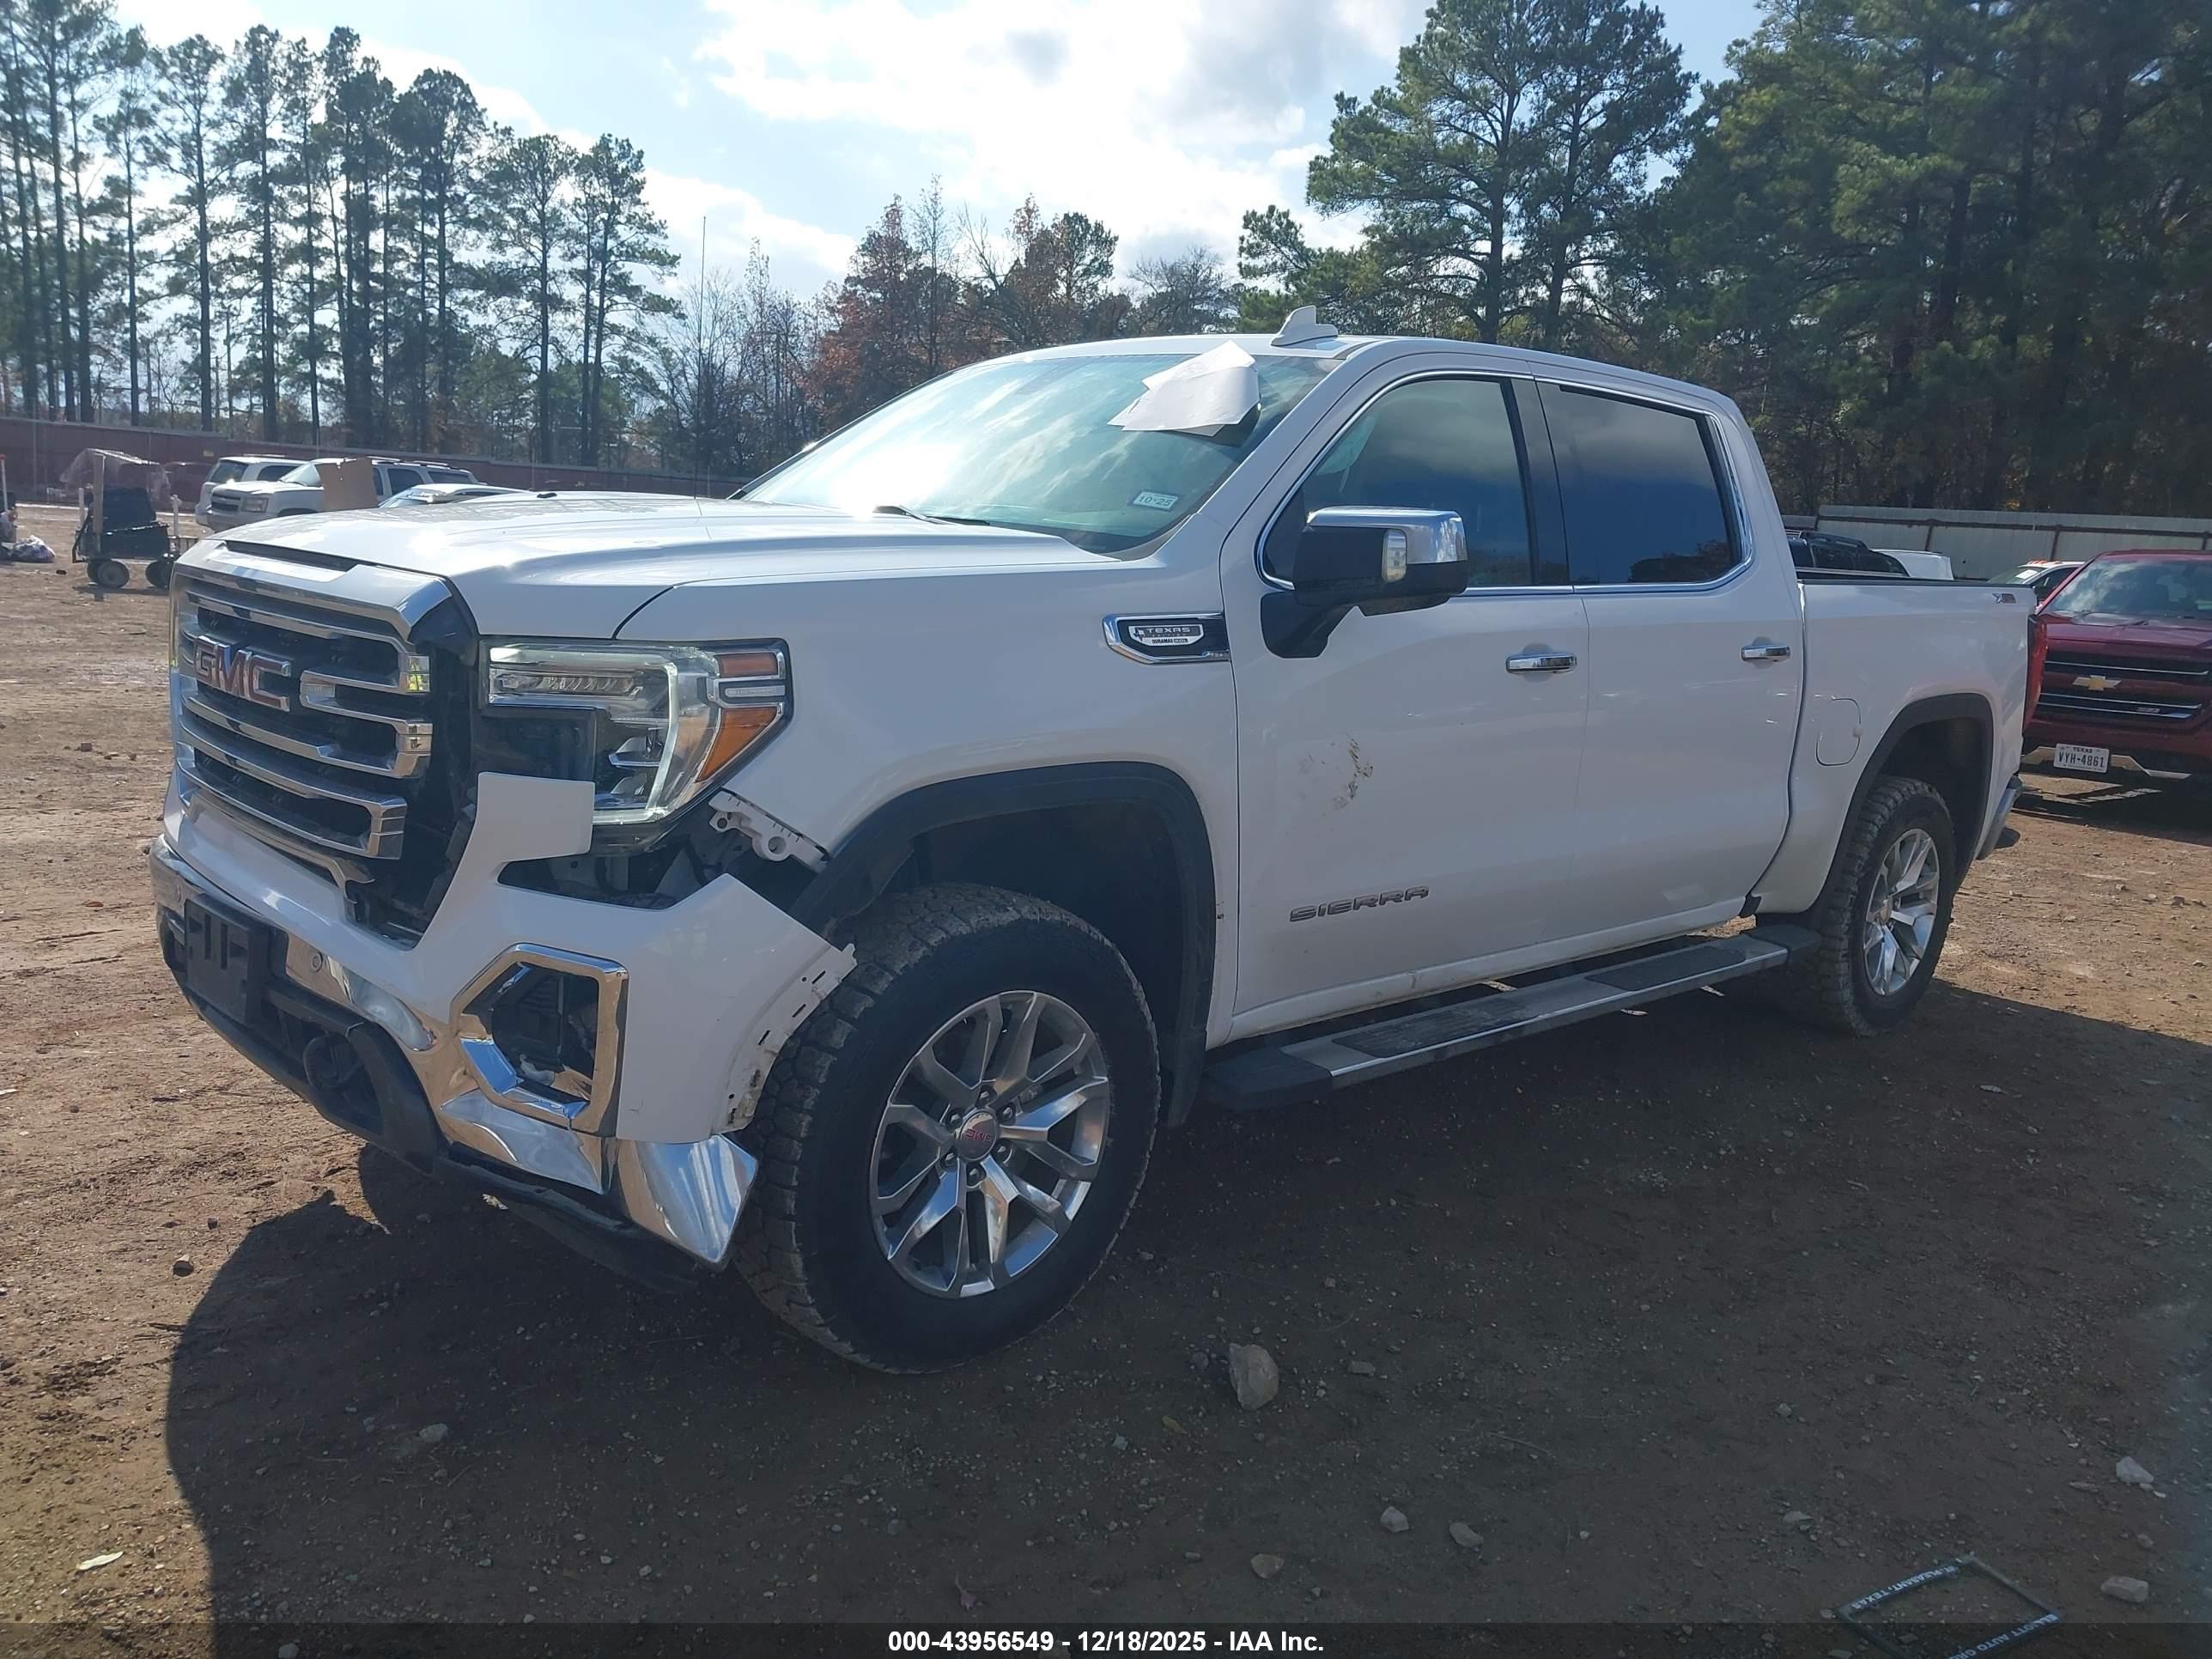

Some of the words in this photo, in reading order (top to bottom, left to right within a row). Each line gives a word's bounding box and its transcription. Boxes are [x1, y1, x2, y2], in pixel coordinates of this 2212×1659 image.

[193, 635, 291, 712] GMC
[2058, 751, 2105, 769] VYH-4861
[1290, 885, 1430, 922] SIERRA
[1977, 1633, 2010, 1651] AUTO
